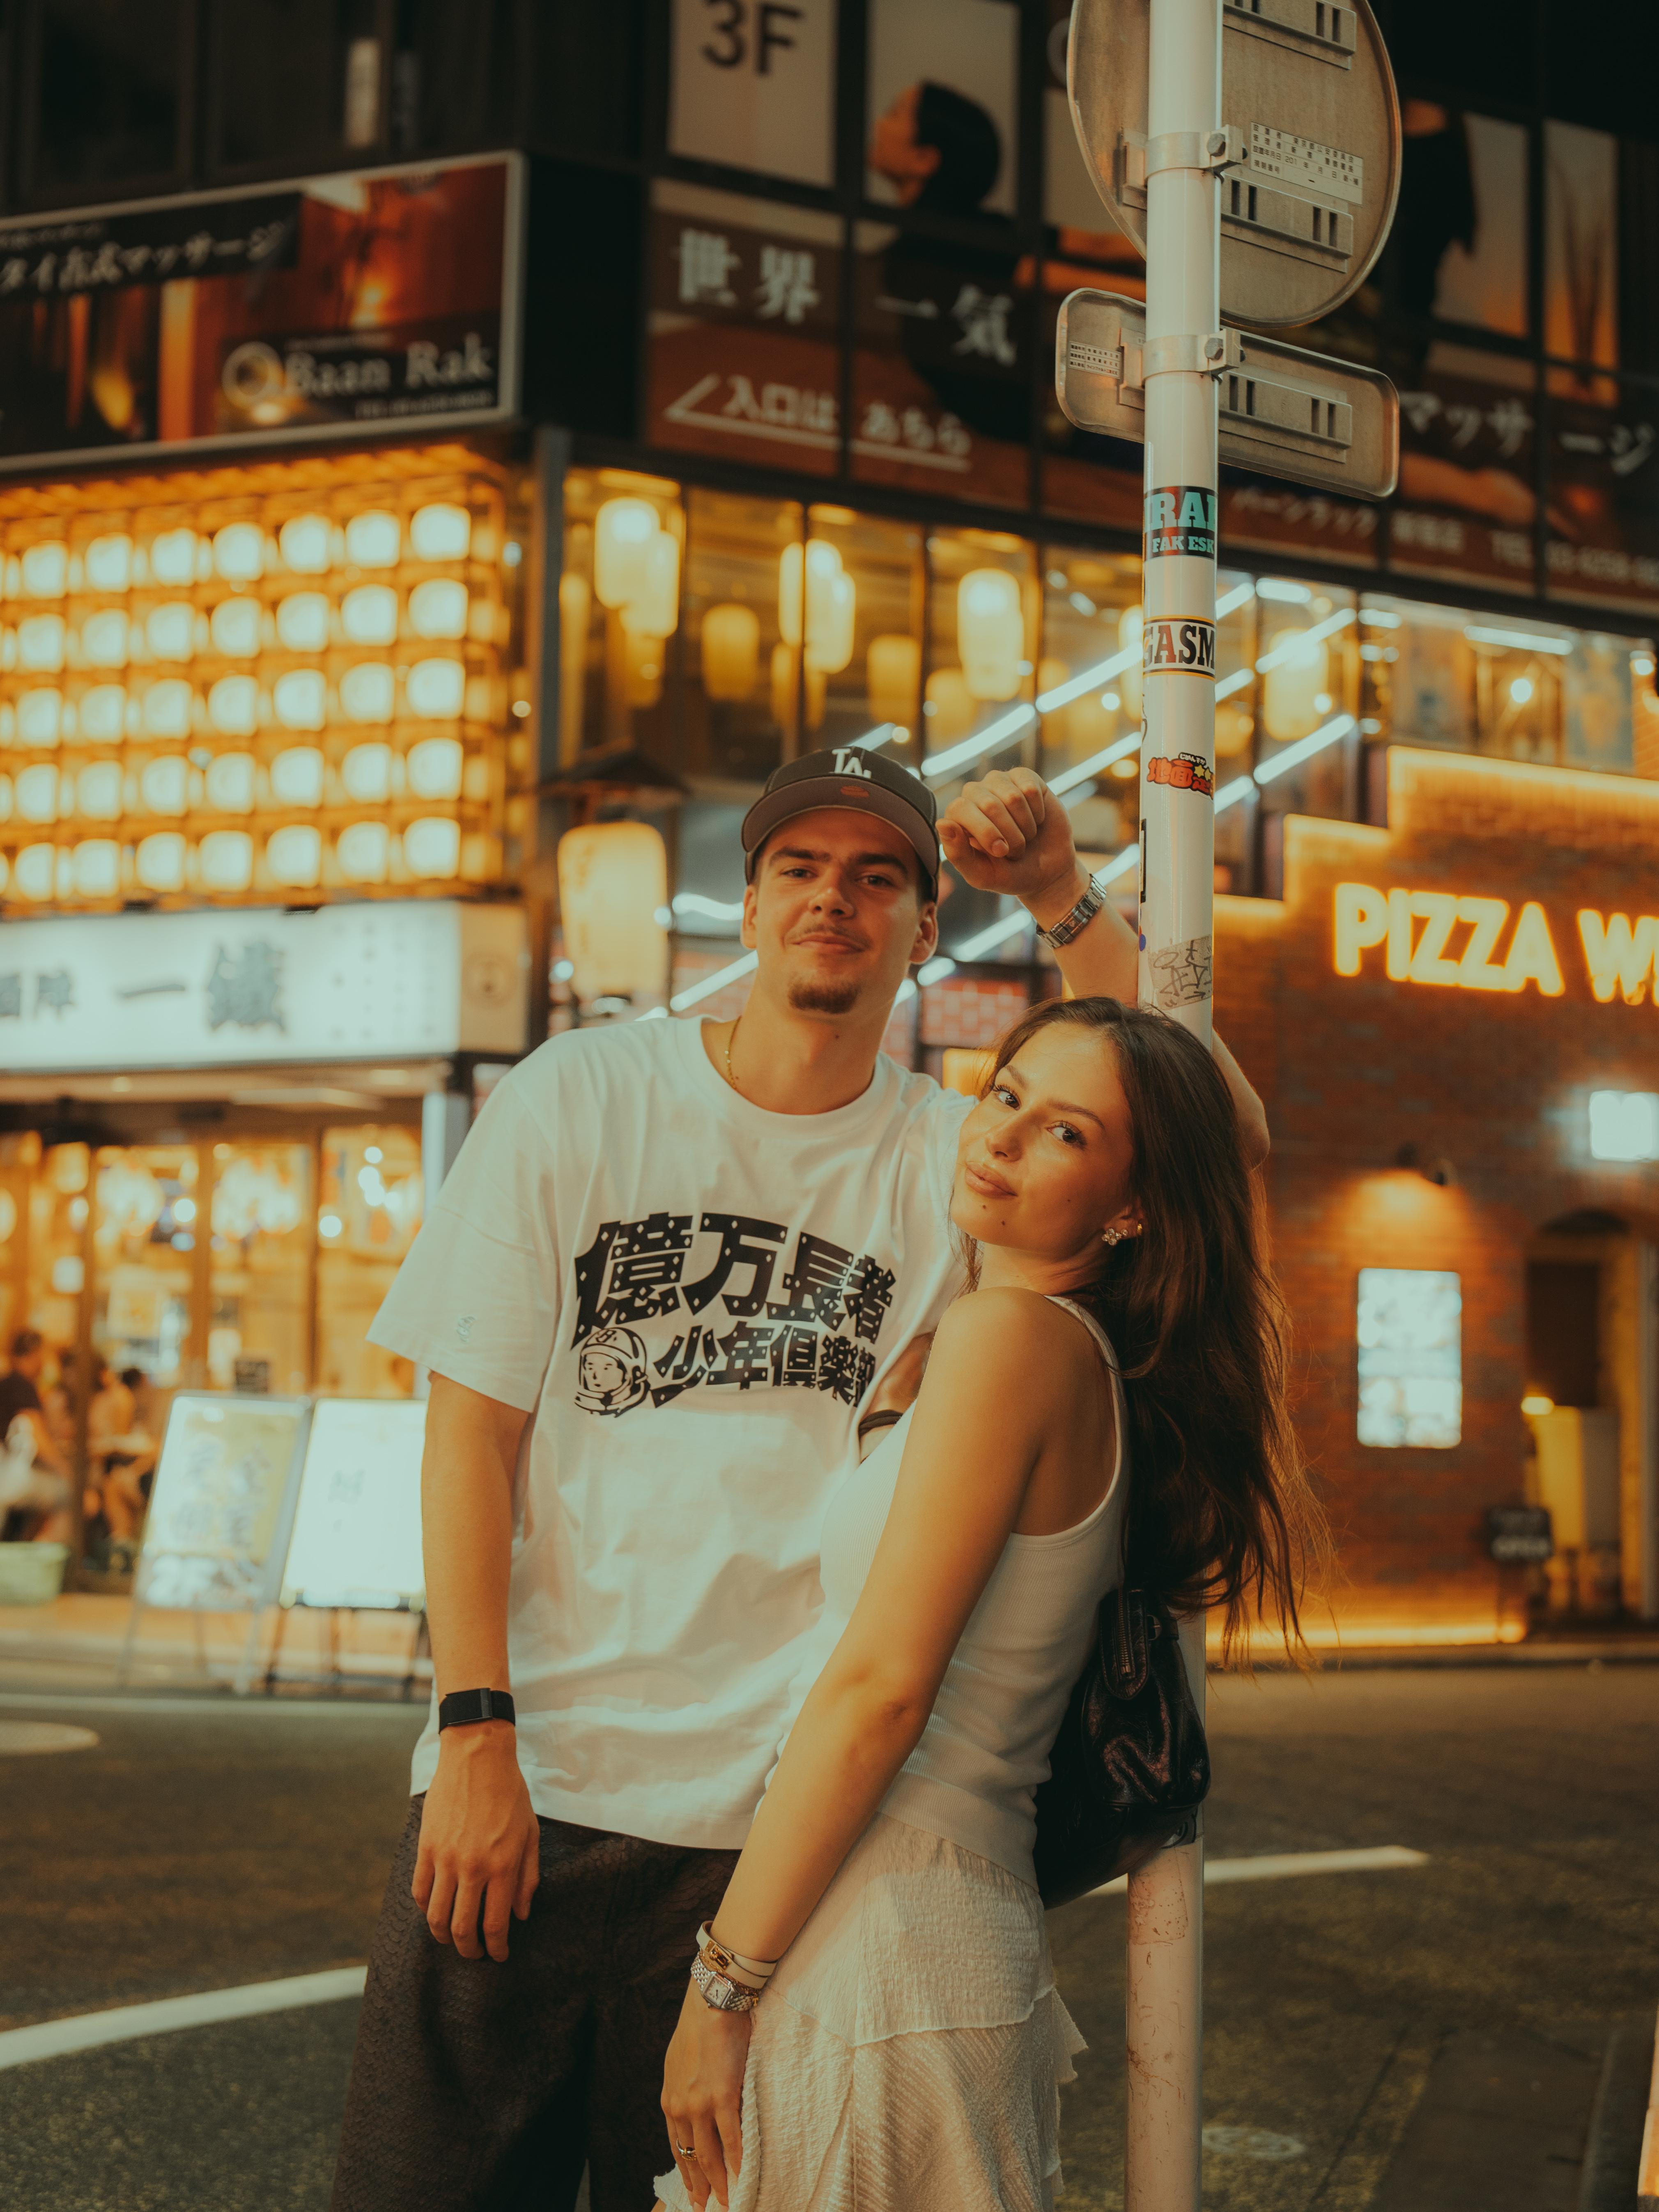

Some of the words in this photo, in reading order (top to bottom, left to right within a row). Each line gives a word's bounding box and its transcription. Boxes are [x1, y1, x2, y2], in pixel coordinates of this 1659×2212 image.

[702, 0, 803, 77] 3F
[404, 332, 496, 388] Rak
[1152, 535, 1184, 553] FAK
[1334, 882, 1565, 998] PIZZA
[571, 1212, 896, 1351] 億万長者
